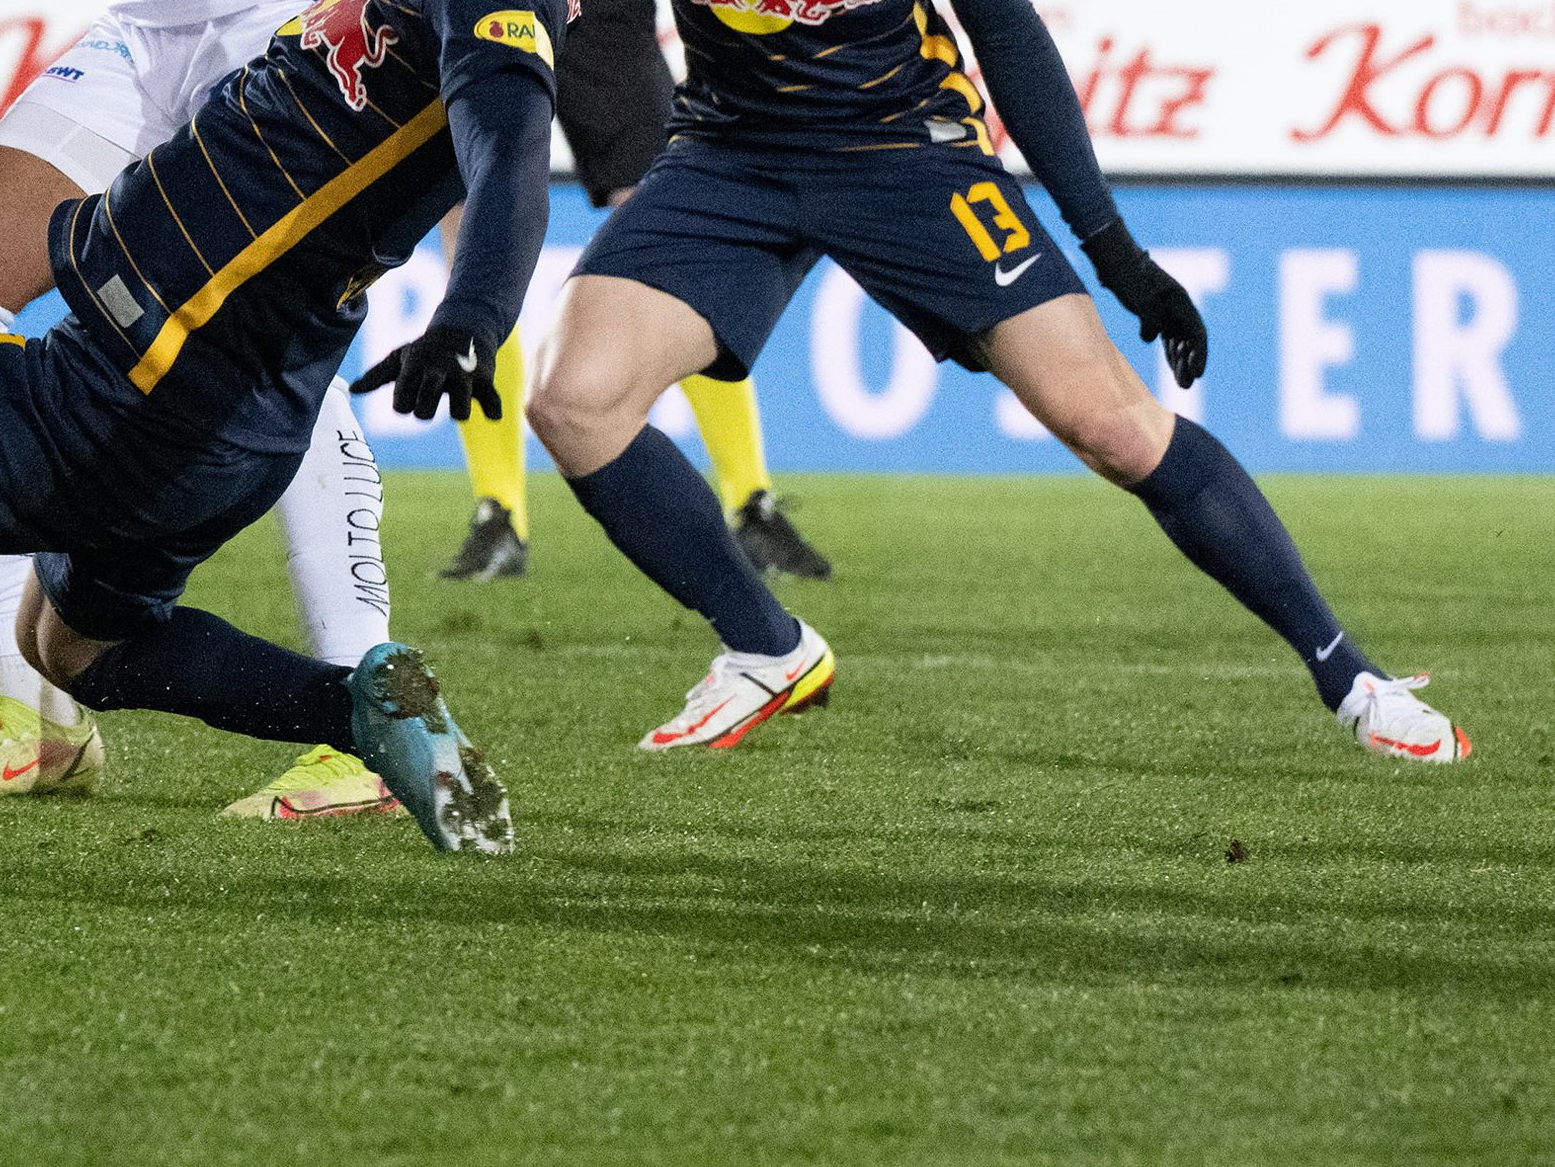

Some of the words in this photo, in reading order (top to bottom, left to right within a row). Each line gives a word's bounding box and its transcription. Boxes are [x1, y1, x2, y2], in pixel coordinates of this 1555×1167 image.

[950, 181, 1031, 263] 13
[337, 430, 384, 503] LUCE
[346, 507, 390, 617] MOLTO
